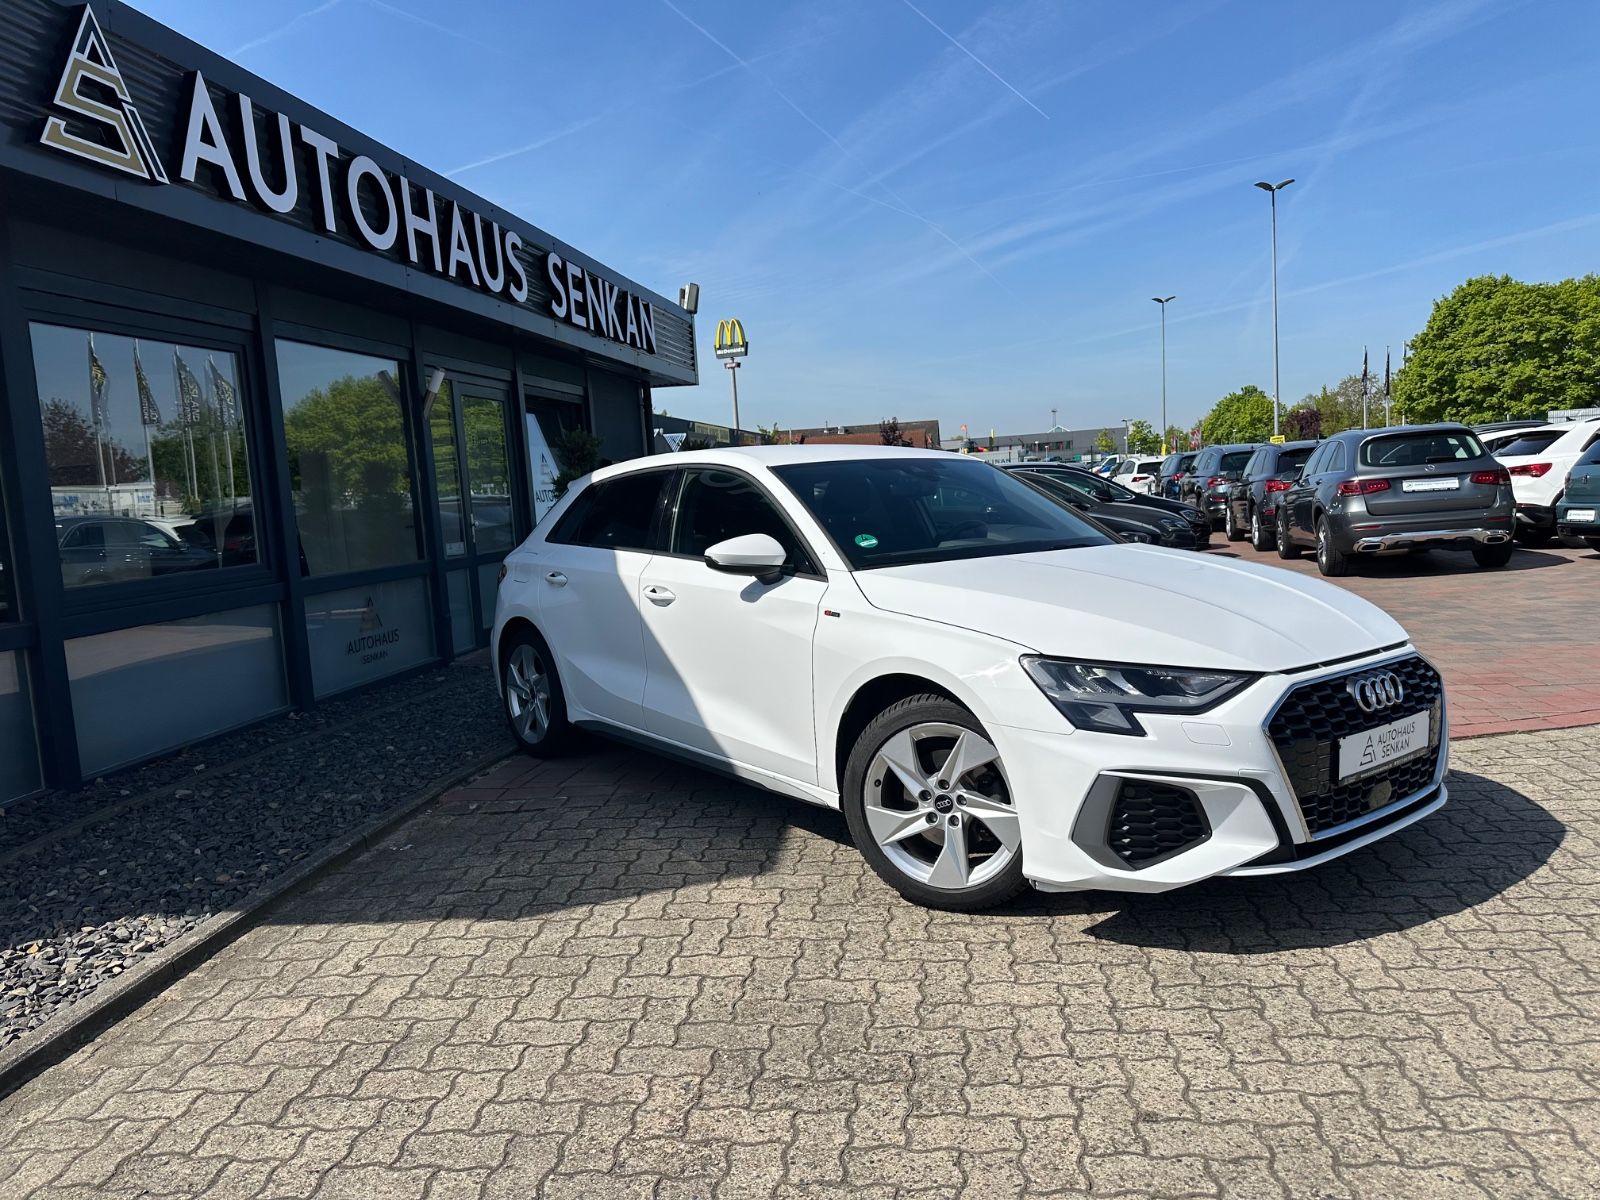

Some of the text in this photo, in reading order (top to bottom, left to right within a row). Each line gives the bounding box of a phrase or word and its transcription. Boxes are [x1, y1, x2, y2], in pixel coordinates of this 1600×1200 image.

[180, 69, 656, 354] AUTOHAUS SENKAN
[347, 629, 400, 656] AUTOHAUS
[1377, 721, 1416, 745] AUTOHAUS
[1381, 737, 1410, 759] SENKAN
